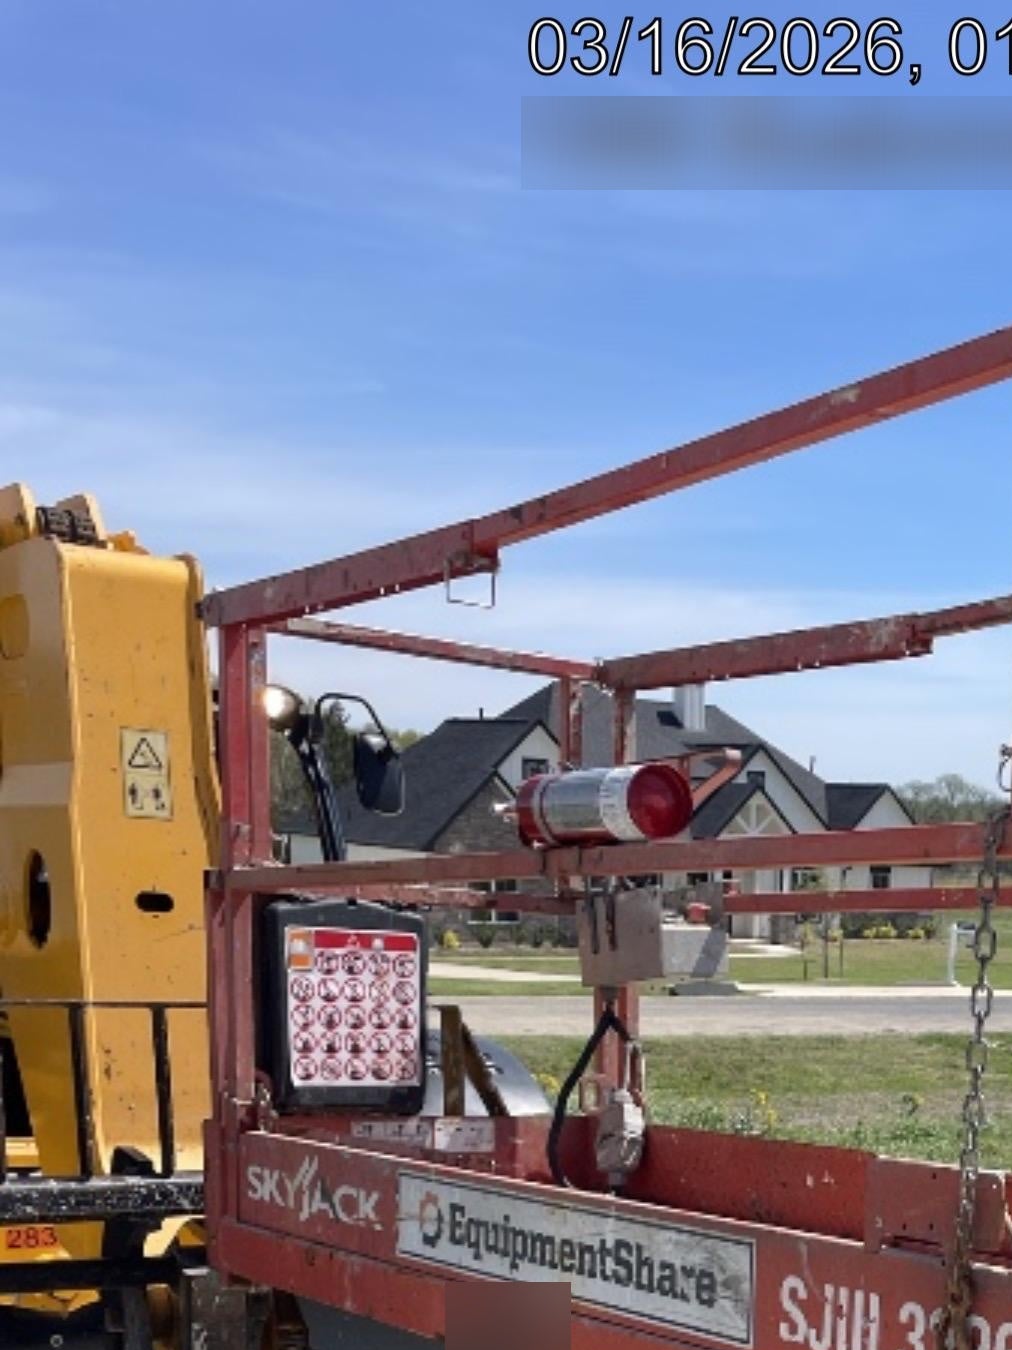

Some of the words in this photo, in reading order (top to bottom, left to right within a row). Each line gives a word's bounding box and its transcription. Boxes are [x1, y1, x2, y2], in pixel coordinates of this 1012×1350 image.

[247, 1155, 384, 1231] SKYJACK
[7, 1227, 57, 1249] 283
[449, 1202, 718, 1308] EquipmentShare
